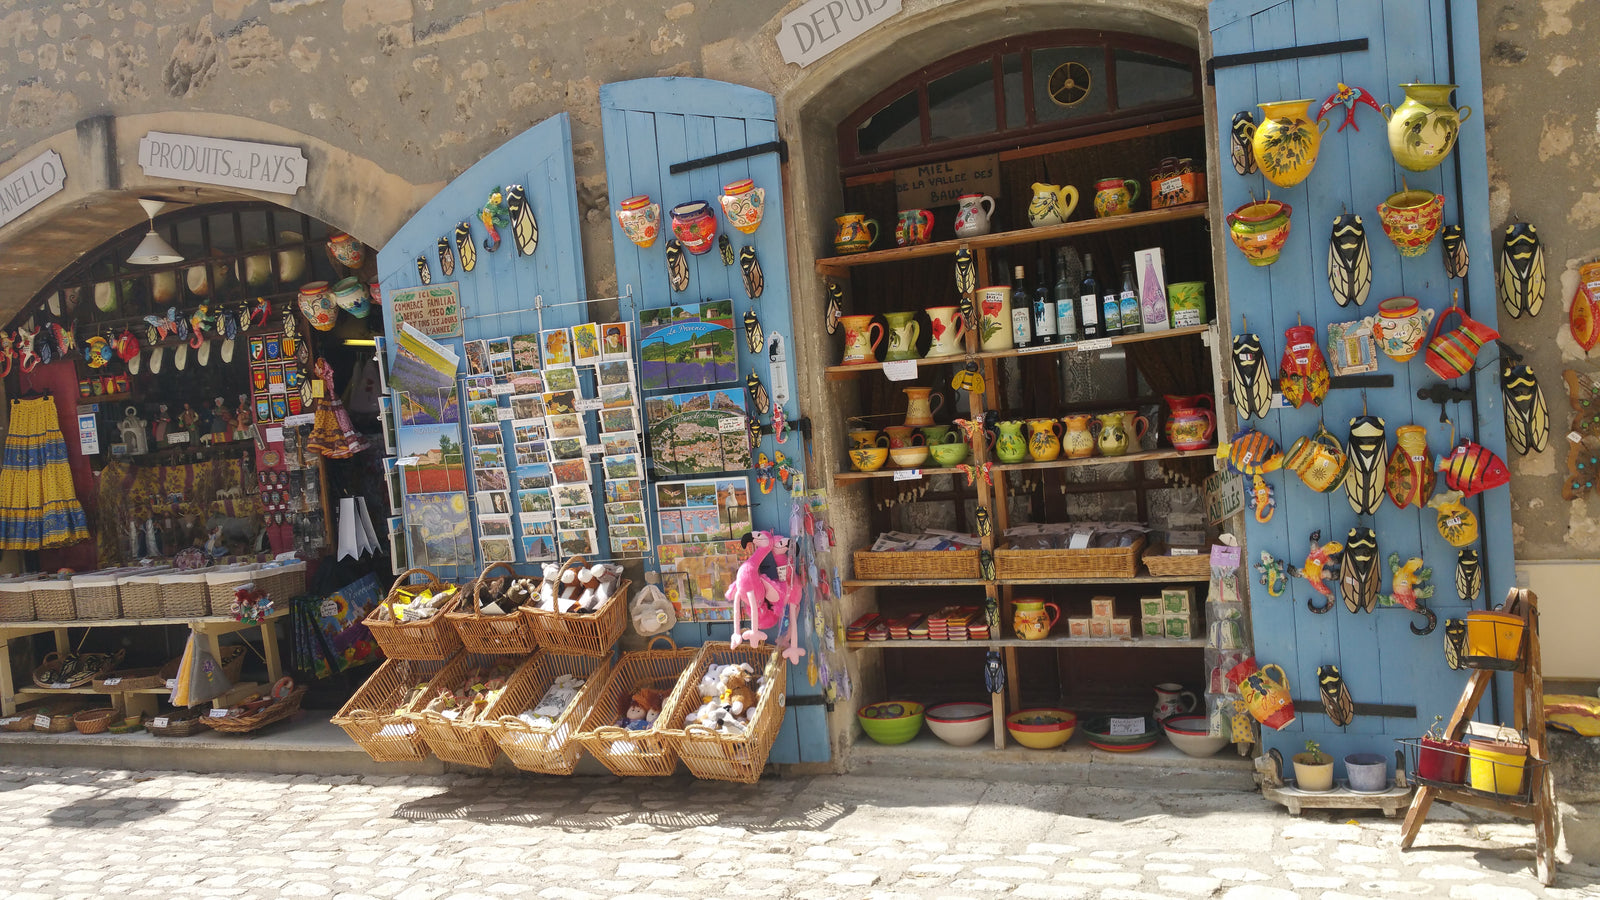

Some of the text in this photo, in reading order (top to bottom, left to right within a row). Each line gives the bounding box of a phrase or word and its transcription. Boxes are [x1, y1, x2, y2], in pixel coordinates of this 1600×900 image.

[149, 140, 233, 177] PRODUITS
[247, 152, 296, 184] PAYS
[918, 163, 954, 177] MIEL
[912, 181, 925, 190] LA
[974, 169, 993, 179] DES
[418, 290, 430, 299] ICI
[394, 296, 456, 312] COMMERCE FAMILIAL
[403, 307, 445, 321] DEPUIS 1950
[431, 318, 440, 326] LES
